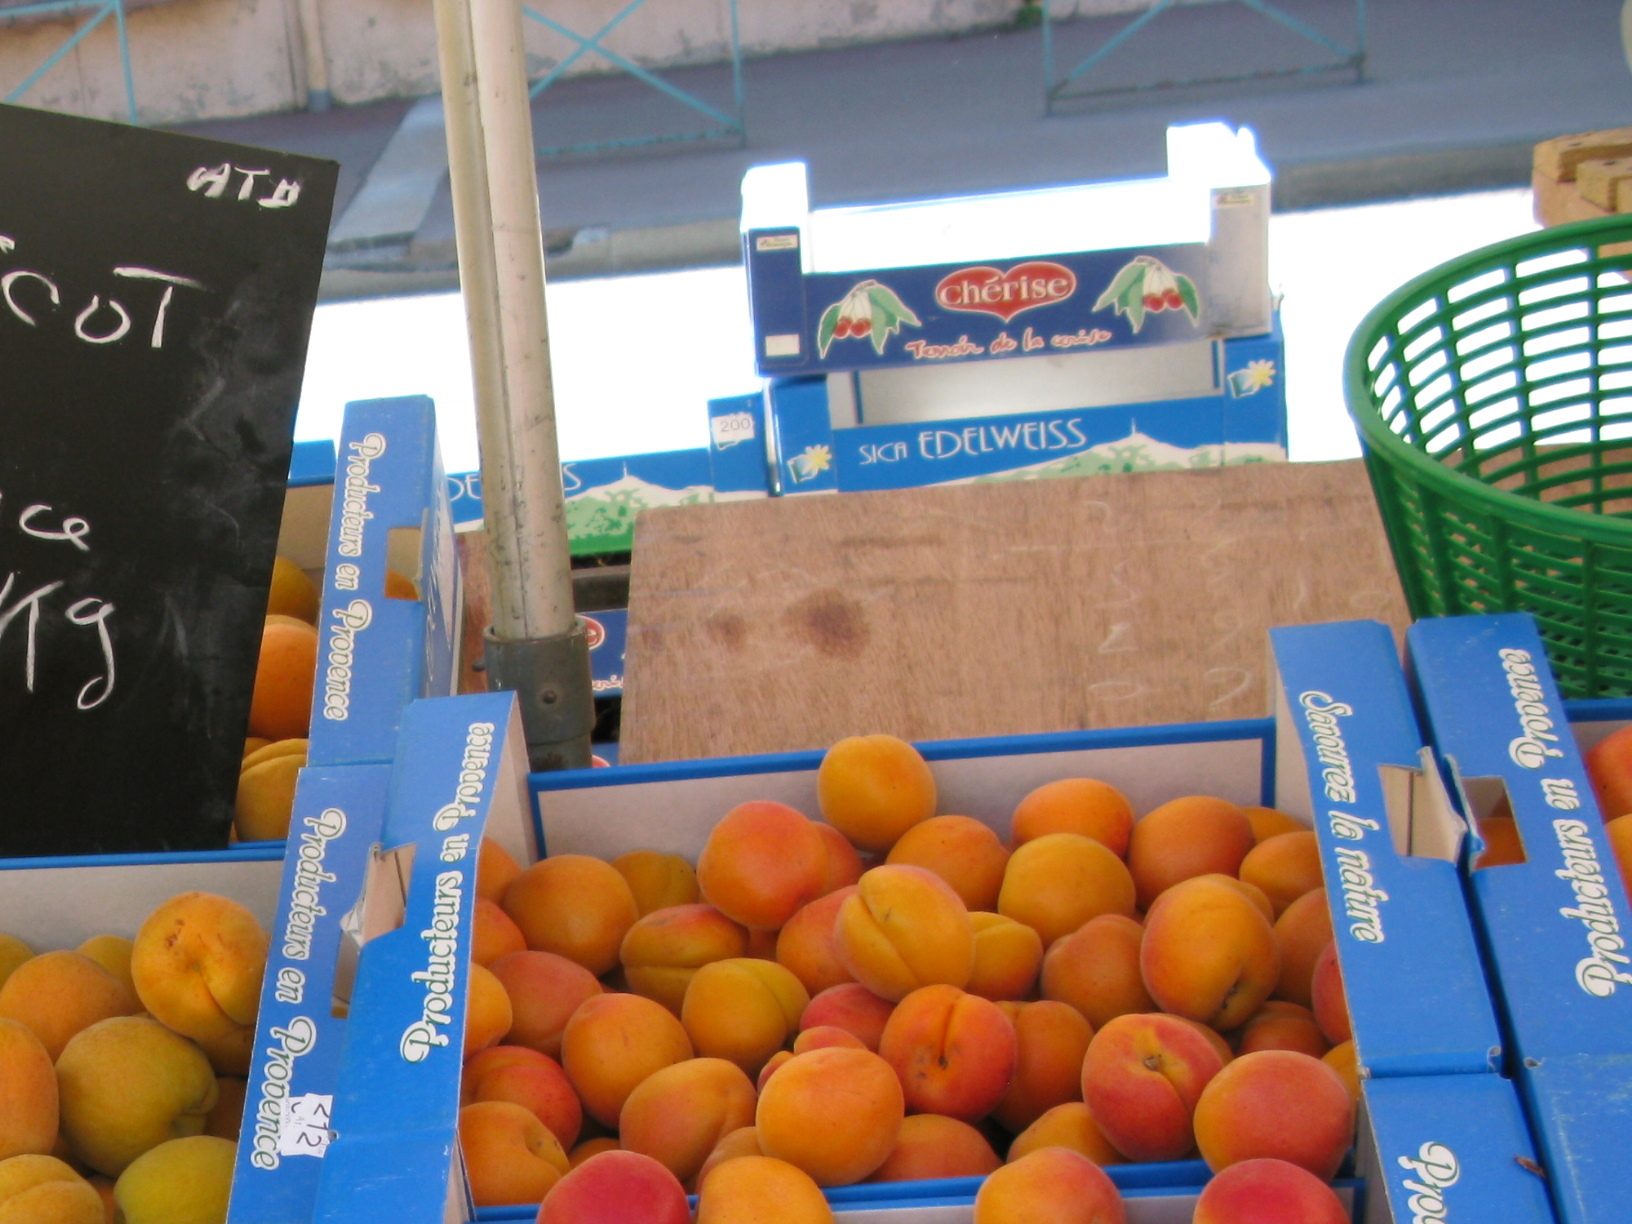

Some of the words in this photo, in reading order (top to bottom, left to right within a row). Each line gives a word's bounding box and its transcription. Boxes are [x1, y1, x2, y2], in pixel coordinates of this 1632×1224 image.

[937, 272, 1069, 306] chérise
[990, 333, 1018, 353] de
[1023, 328, 1045, 350] la
[720, 417, 751, 433] 200
[858, 441, 908, 466] SICA
[919, 418, 1088, 460] EDELWEISS
[337, 432, 386, 557] Producteurs
[334, 562, 361, 591] en
[324, 599, 372, 721] Provence
[1299, 690, 1356, 803] Savourez
[1499, 648, 1564, 770] Provence
[433, 722, 494, 832] Provence
[1328, 810, 1380, 841] la
[1540, 778, 1580, 811] en
[282, 807, 347, 960] Producteurs
[439, 833, 470, 864] en
[1335, 847, 1389, 944] nature
[1553, 819, 1632, 998] Producteurs
[275, 967, 306, 1004] en
[400, 870, 464, 1063] Producteurs
[250, 1016, 316, 1170] Provence
